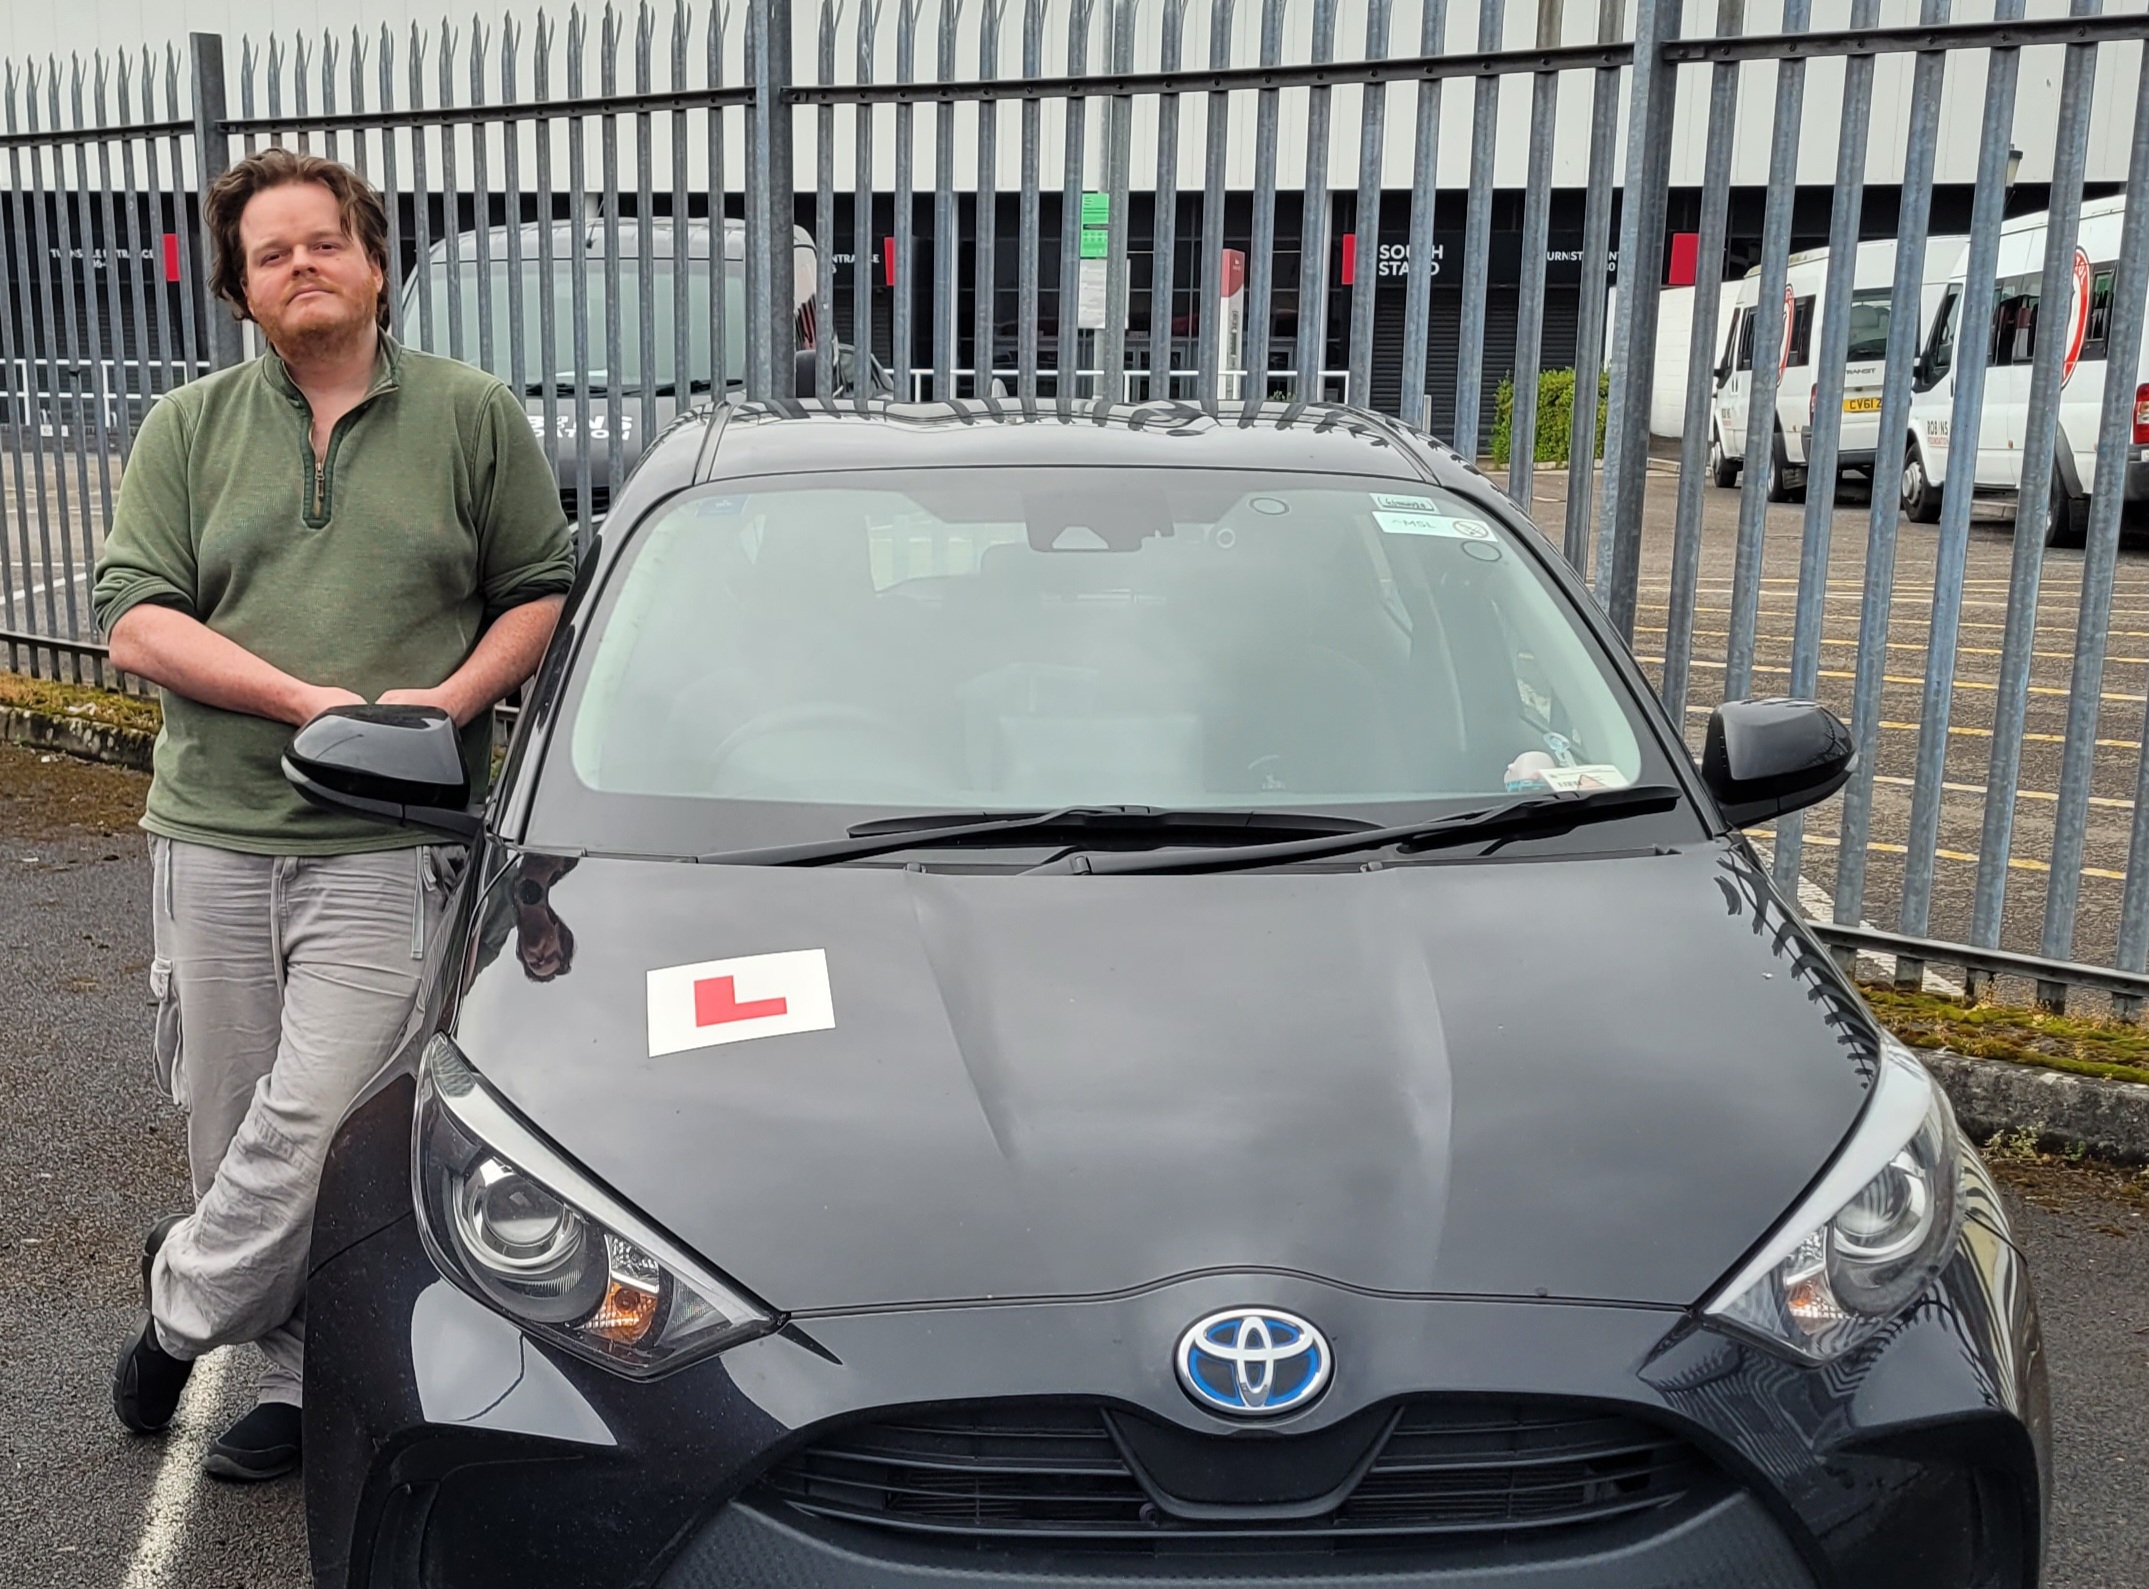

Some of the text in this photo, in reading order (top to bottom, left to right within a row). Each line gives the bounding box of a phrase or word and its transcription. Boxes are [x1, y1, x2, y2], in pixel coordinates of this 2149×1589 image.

[1379, 244, 1444, 260] SOH
[1379, 261, 1440, 276] STAD
[693, 975, 788, 1028] L
